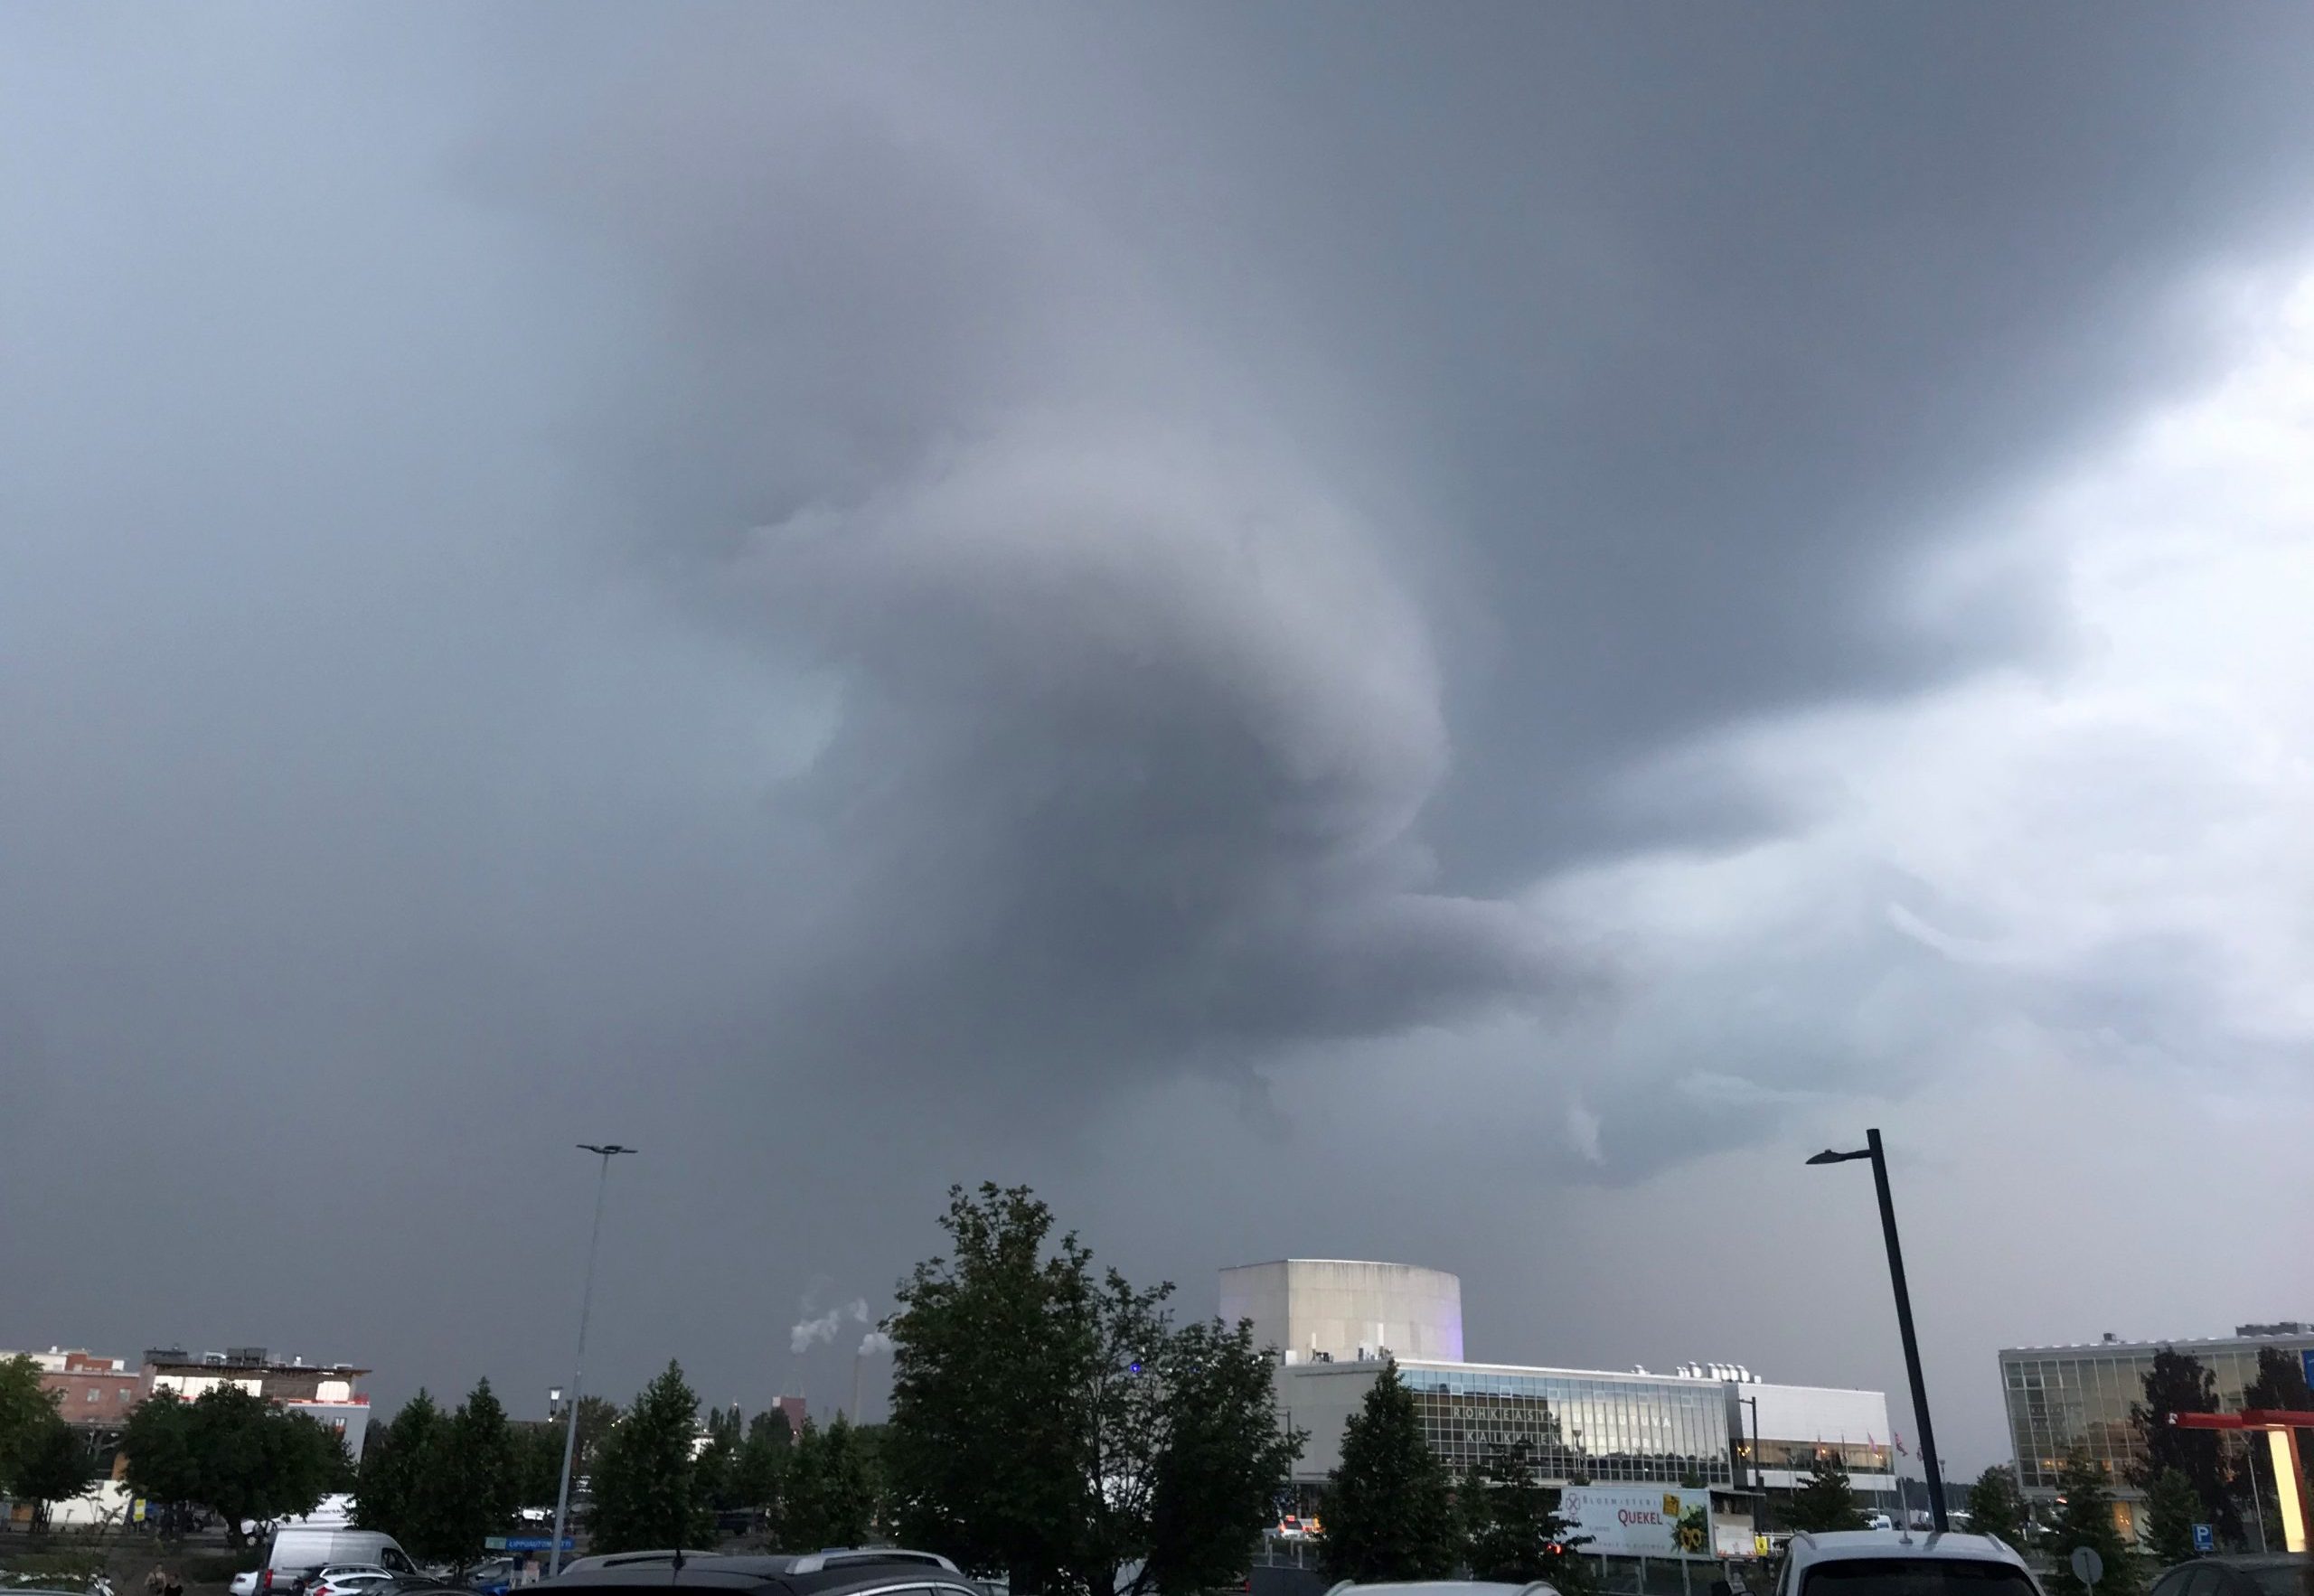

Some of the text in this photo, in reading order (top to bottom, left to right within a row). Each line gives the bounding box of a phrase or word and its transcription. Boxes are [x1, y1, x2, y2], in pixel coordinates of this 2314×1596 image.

[1574, 1412, 1671, 1428] UUSIUTUVA
[1466, 1431, 1558, 1445] KAIKKIEN
[1617, 1508, 1663, 1527] QUEKEL
[2196, 1526, 2209, 1542] P
